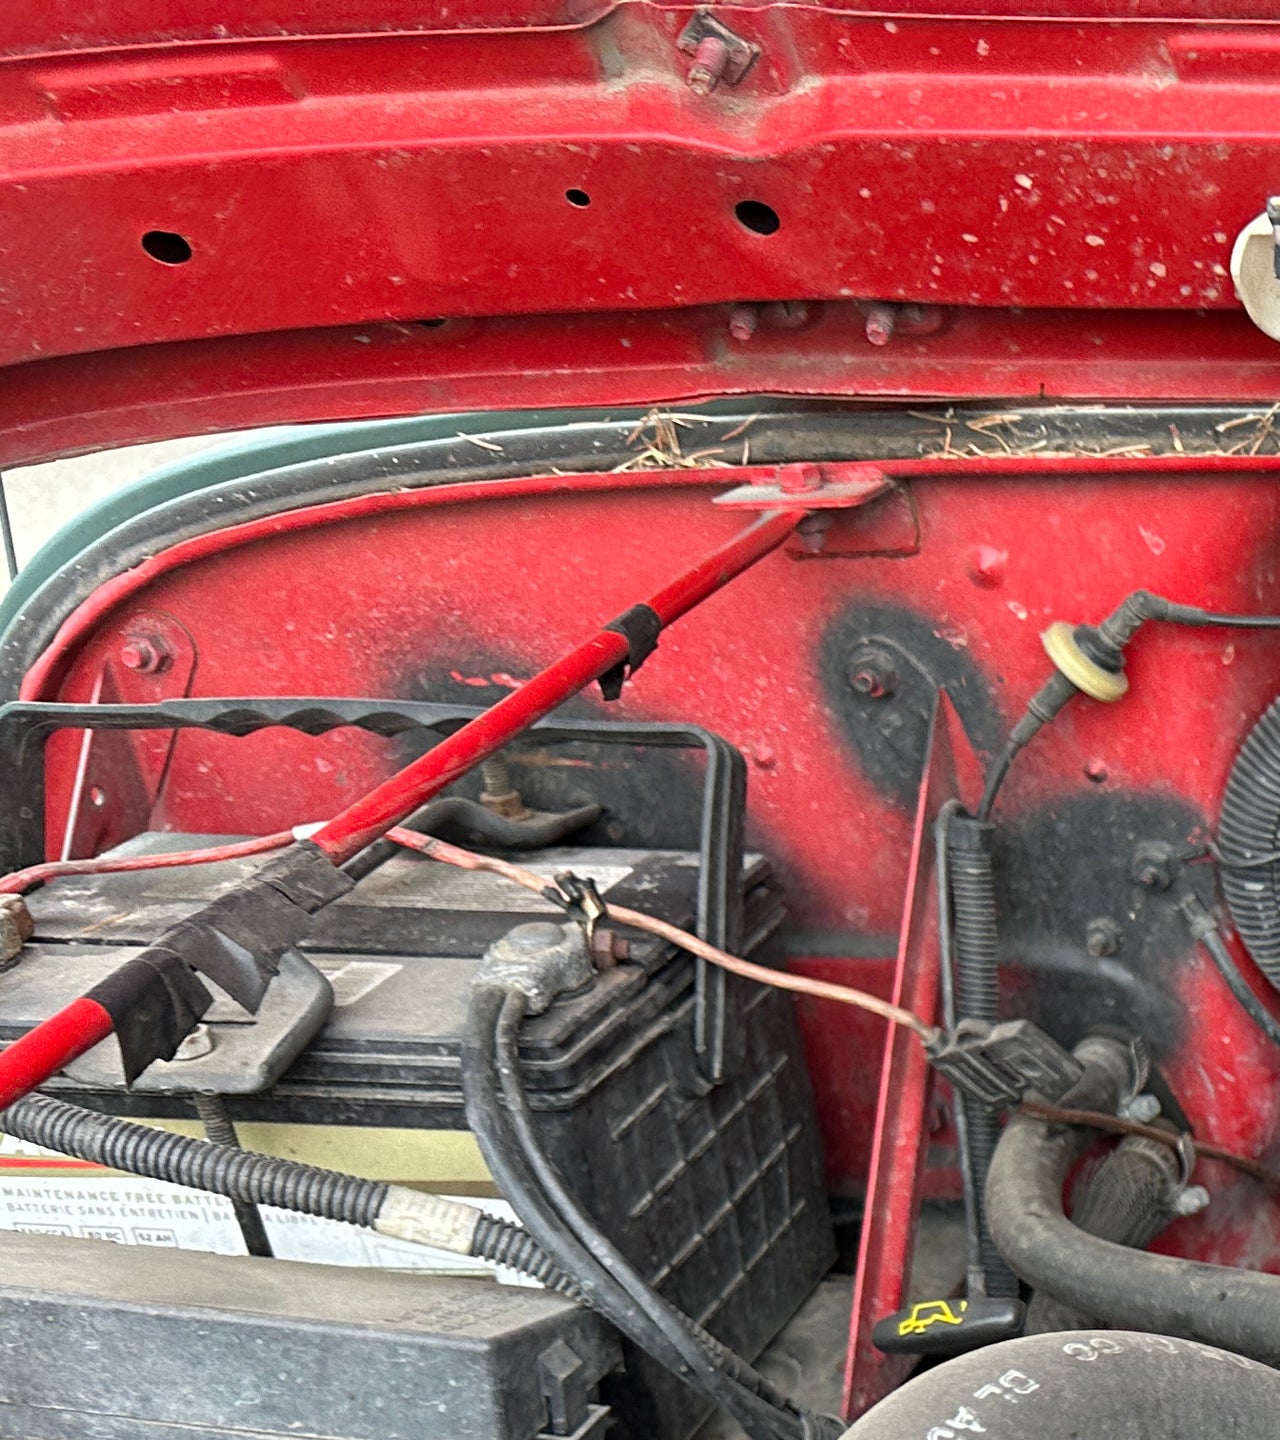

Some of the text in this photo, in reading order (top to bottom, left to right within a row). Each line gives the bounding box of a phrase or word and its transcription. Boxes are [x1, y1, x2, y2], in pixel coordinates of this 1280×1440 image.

[2, 1187, 231, 1206] MAINTENANCE FREE BATTE
[6, 1202, 74, 1216] BATTERIE
[77, 1205, 116, 1217] SANS
